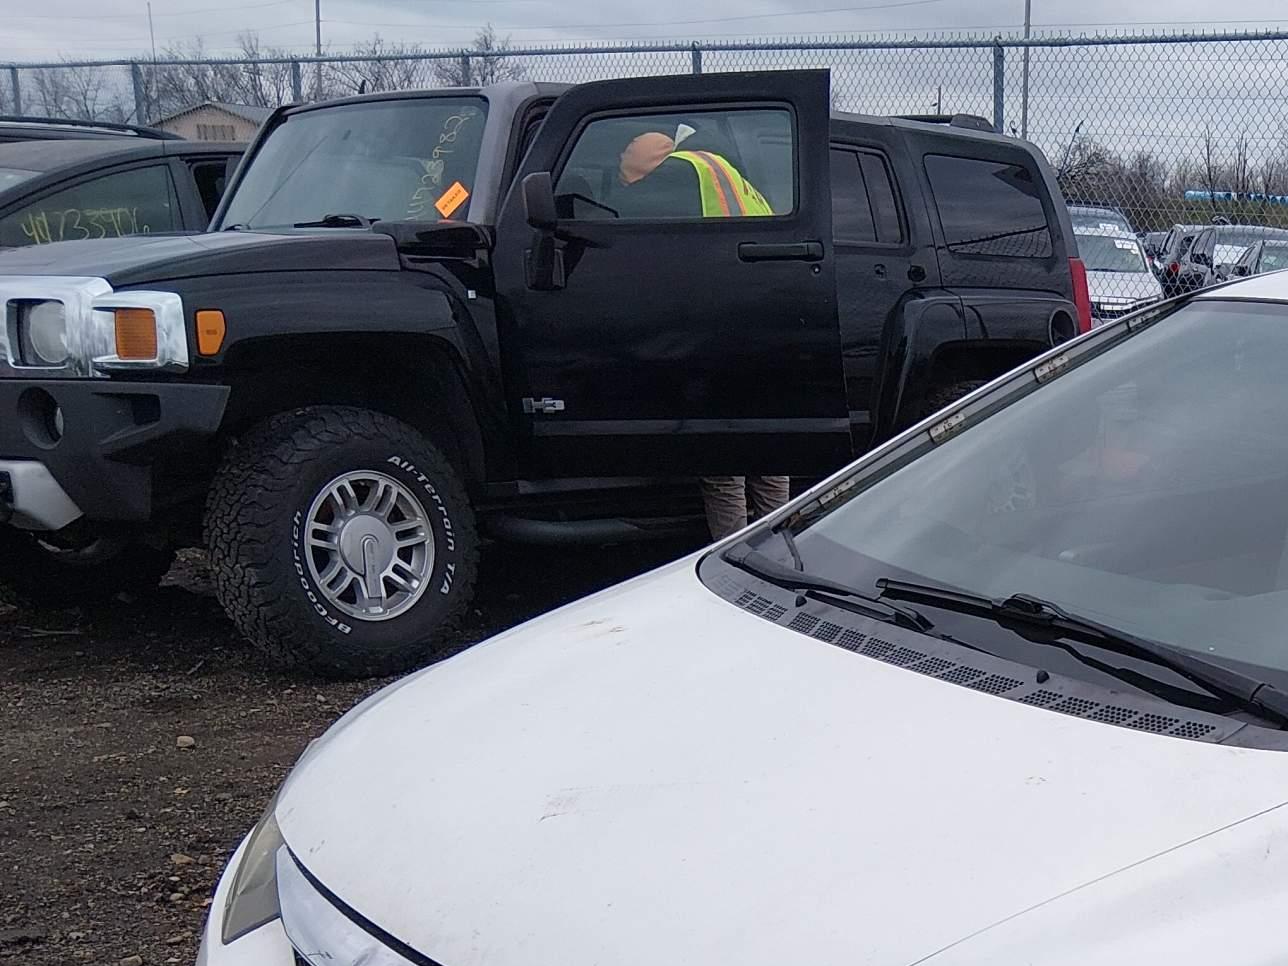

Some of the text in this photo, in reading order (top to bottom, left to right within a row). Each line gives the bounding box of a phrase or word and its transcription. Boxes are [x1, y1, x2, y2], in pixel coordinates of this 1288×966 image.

[292, 511, 352, 635] BFGoodrich
[387, 455, 455, 595] All-Terrain T/A
